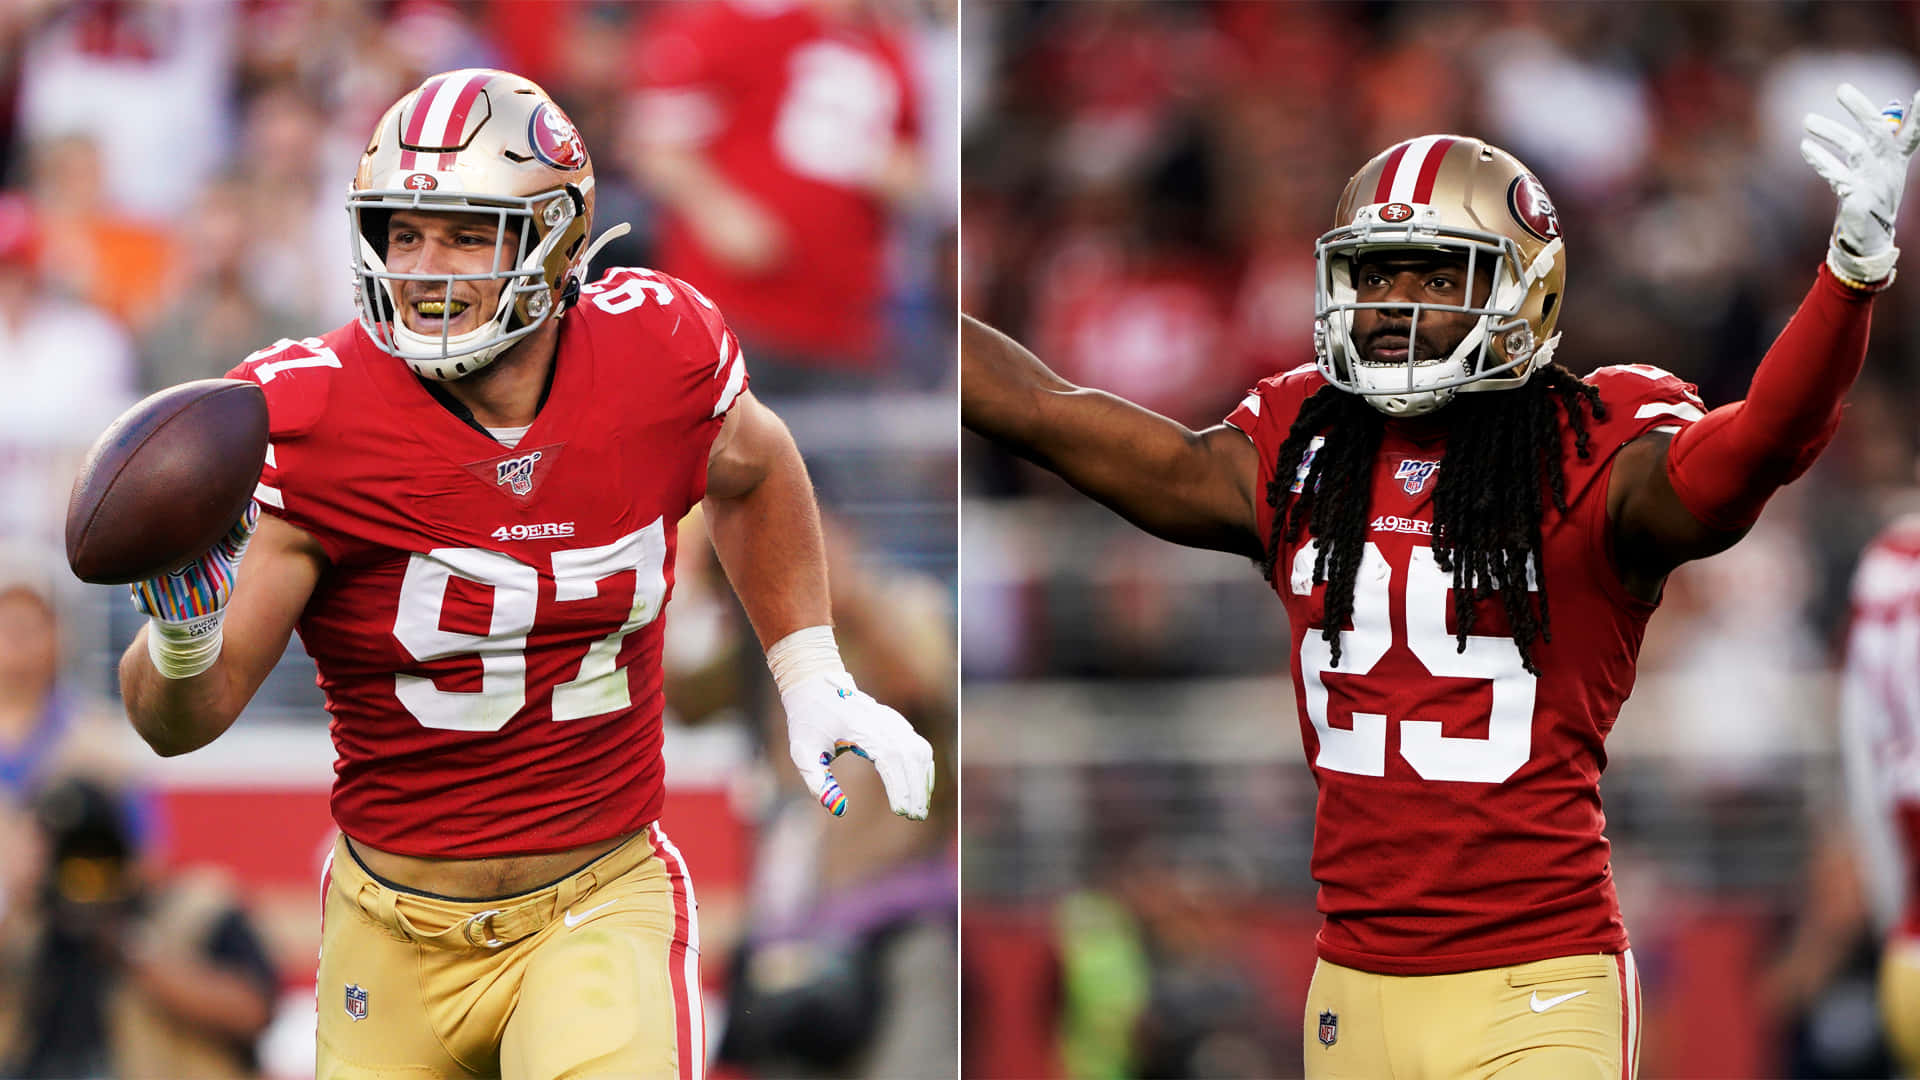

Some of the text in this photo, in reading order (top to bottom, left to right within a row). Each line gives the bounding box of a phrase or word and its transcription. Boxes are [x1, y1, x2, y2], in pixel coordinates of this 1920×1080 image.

[491, 522, 575, 541] 49ERS
[190, 619, 218, 637] CATCH
[392, 514, 667, 732] 97
[1290, 537, 1540, 784] 25
[348, 997, 365, 1014] NFL
